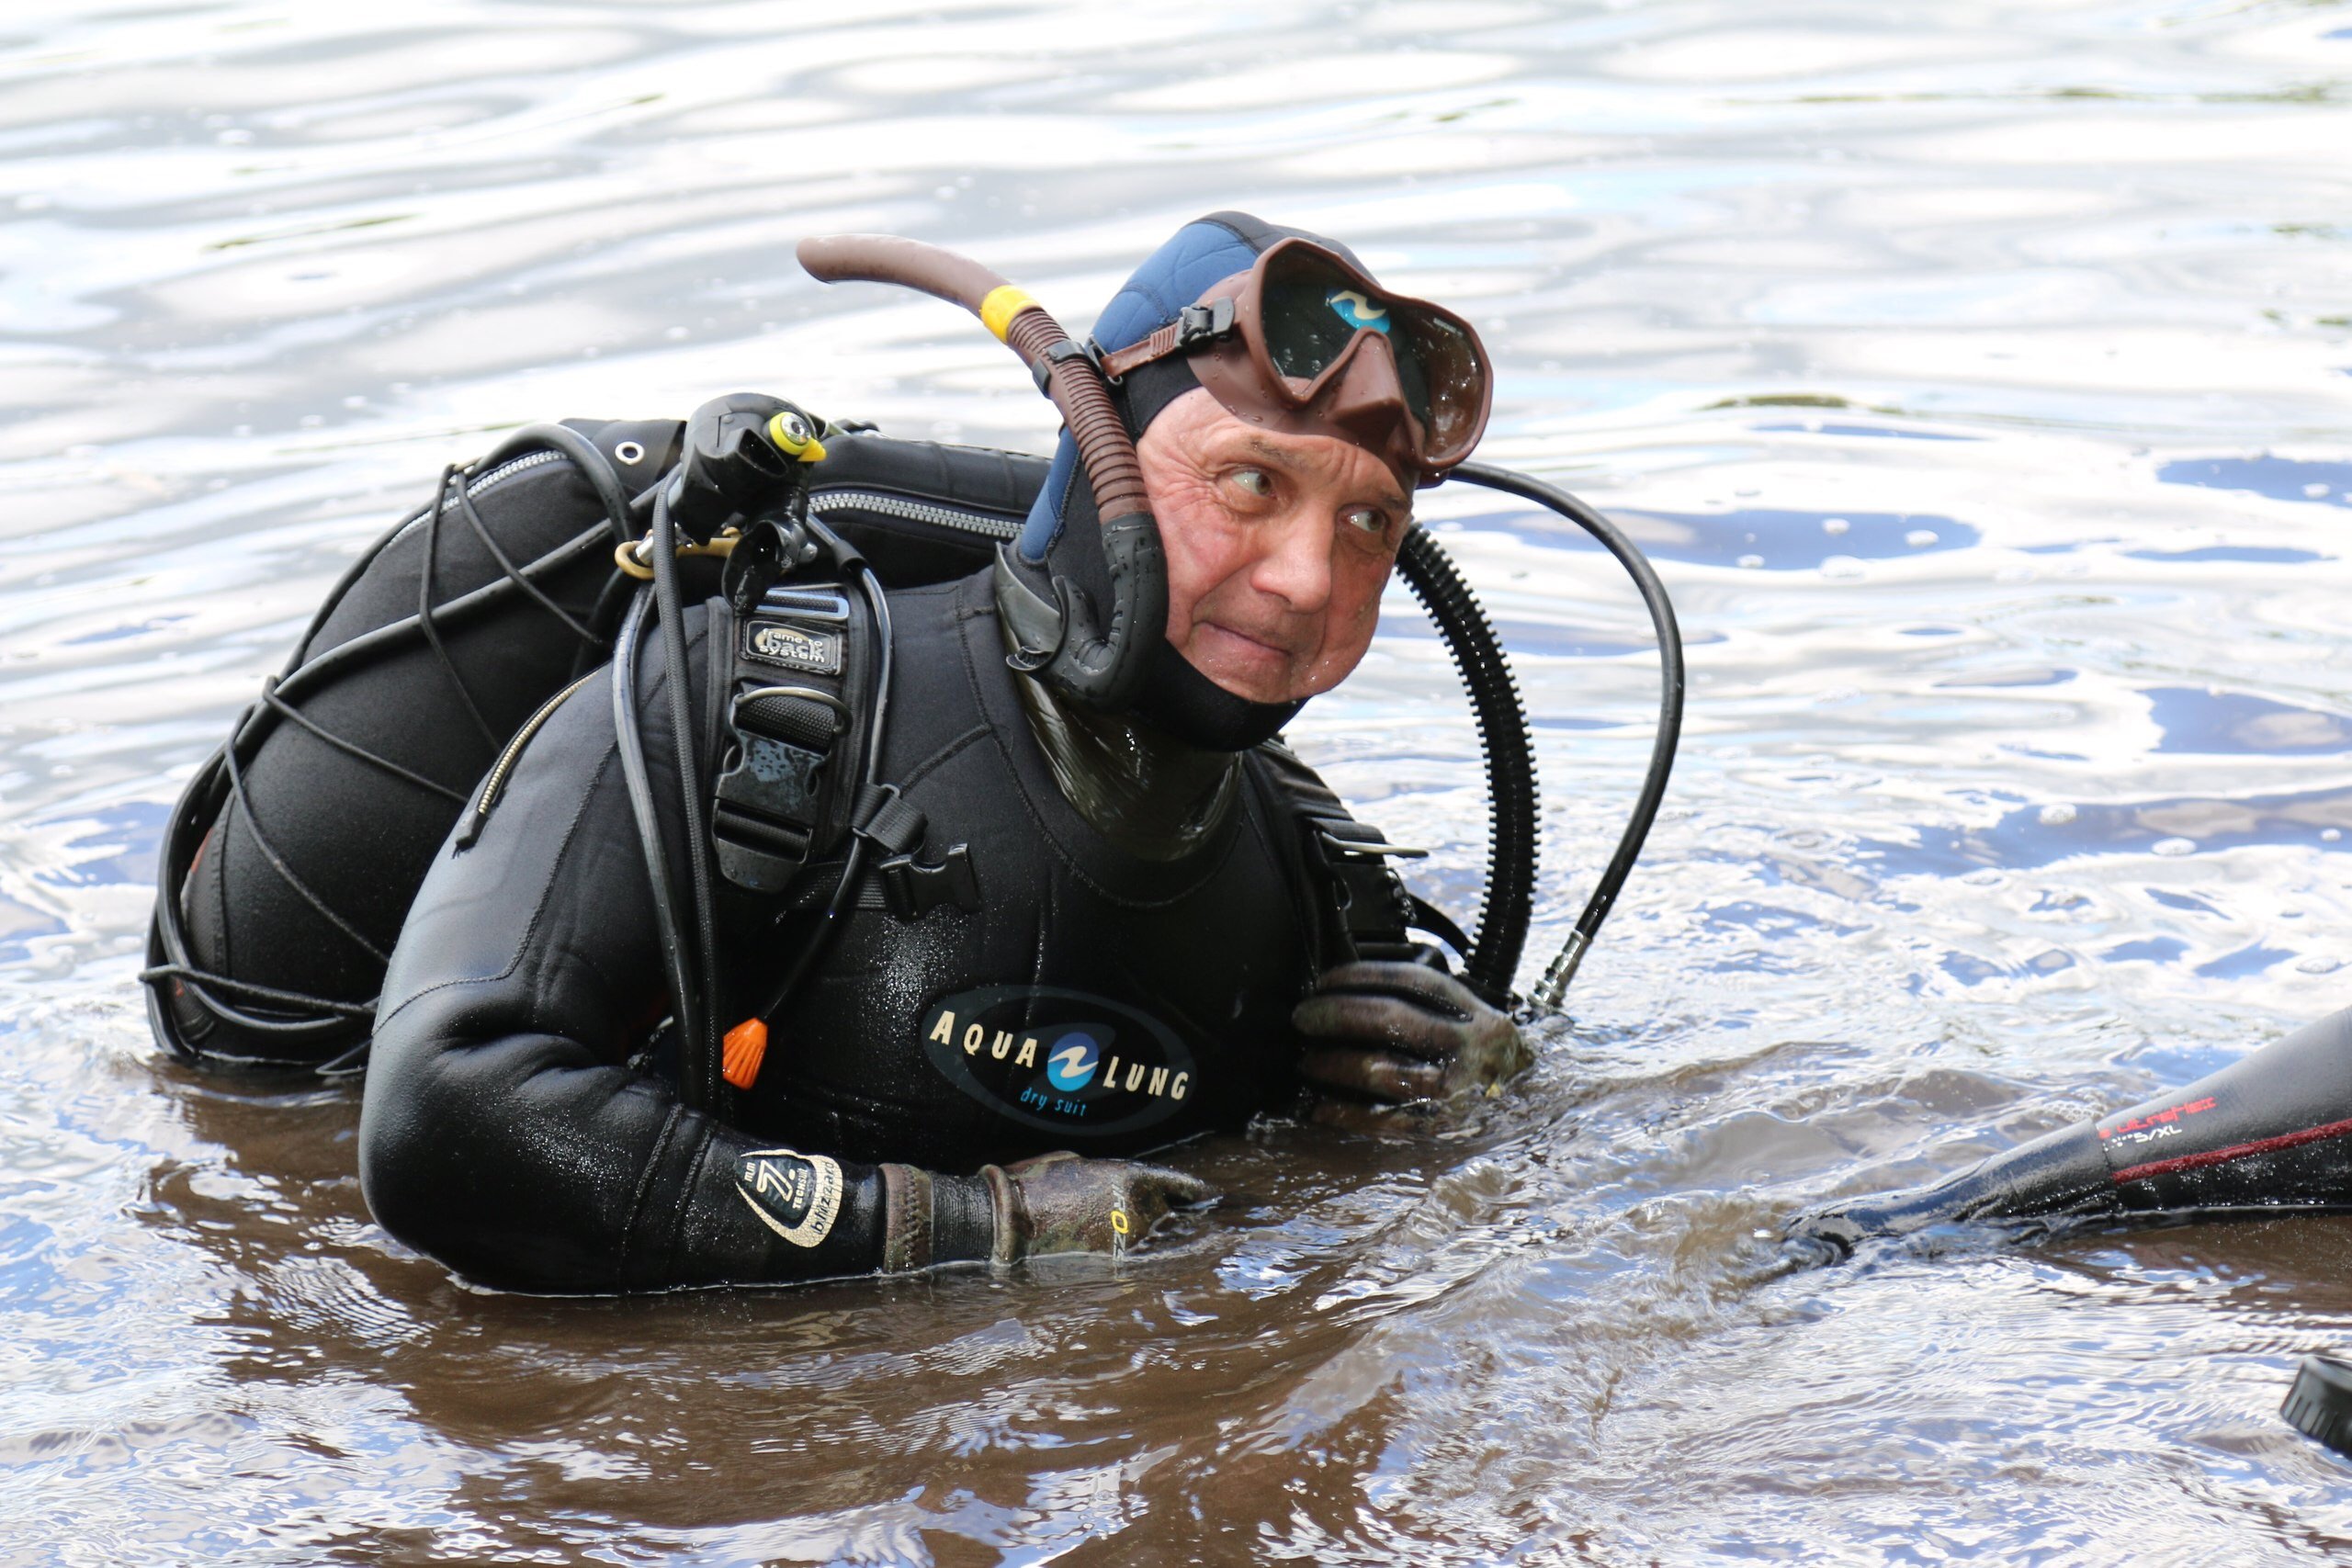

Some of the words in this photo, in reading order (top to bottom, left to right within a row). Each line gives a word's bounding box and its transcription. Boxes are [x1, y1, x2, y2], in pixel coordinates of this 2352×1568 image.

[759, 645, 825, 662] system
[929, 1010, 1038, 1068] AQUA
[1102, 1056, 1189, 1100] LUNG
[1020, 1087, 1047, 1111] dry
[1055, 1099, 1087, 1117] suit
